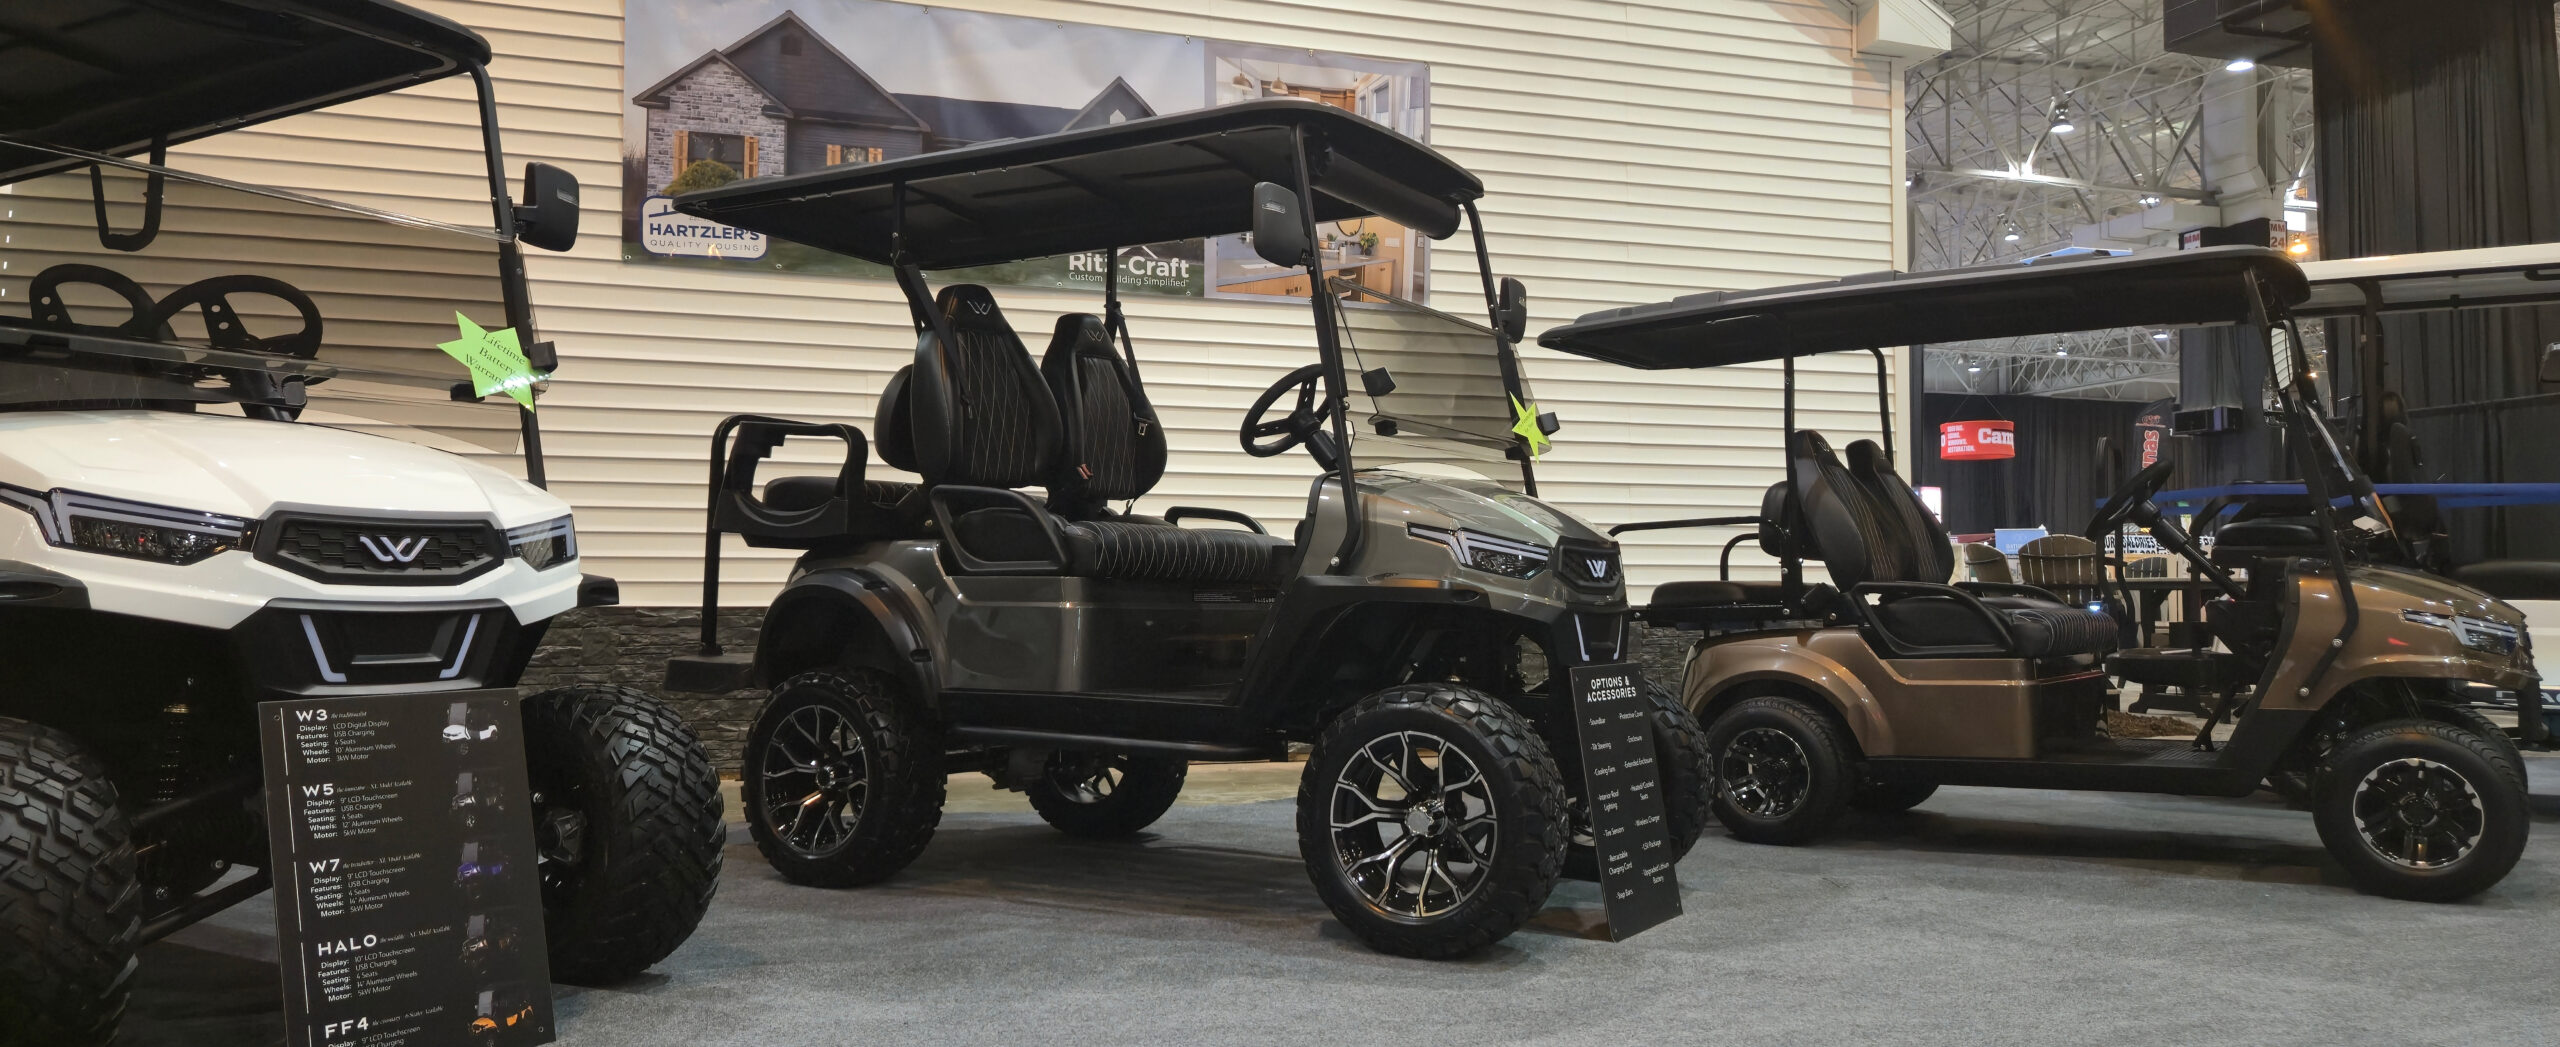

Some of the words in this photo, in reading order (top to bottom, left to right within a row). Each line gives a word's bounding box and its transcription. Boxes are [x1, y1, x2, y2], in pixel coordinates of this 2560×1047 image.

[650, 223, 760, 241] HARTZLER'S
[2270, 223, 2285, 232] MM
[650, 239, 702, 249] QUALITY
[2270, 237, 2285, 247] 24
[1069, 253, 1190, 278] Rit-Craft
[1069, 272, 1103, 282] Custom
[482, 332, 526, 365] Lifetime
[480, 347, 516, 375] Battery
[1591, 676, 1623, 689] OPTIONS
[1624, 675, 1630, 686] &
[1587, 686, 1637, 703] ACCESSORIES
[347, 721, 367, 730] Digital
[368, 720, 390, 728] Display
[347, 729, 375, 737] Charging
[345, 745, 374, 753] Aluminum
[306, 799, 335, 807] Display:
[347, 795, 361, 803] LCD
[362, 793, 398, 802] Touchscreen
[303, 807, 336, 815] Features:
[341, 804, 354, 812] USB
[354, 802, 382, 811] Charging
[307, 815, 336, 824] Seating:
[309, 823, 337, 831] Wheels:
[351, 819, 381, 827] Aluminum
[381, 816, 403, 824] Wheels
[1608, 865, 1624, 875] Charging
[1624, 861, 1633, 871] Cord
[313, 876, 342, 885] Display:
[354, 871, 368, 879] LCD
[369, 867, 405, 877] Touchscreen
[310, 884, 343, 894] Features:
[362, 877, 390, 886] Charging
[315, 892, 344, 902] Seating:
[353, 888, 371, 896] Seats
[316, 900, 344, 910] Wheels:
[358, 894, 388, 903] Aluminum
[388, 889, 410, 898] Wheels
[320, 909, 345, 918] Motor:
[350, 905, 364, 913] 5kW
[364, 903, 384, 911] Motor
[317, 934, 377, 957] HALO
[320, 959, 349, 969] Display:
[364, 953, 378, 961] LCD
[378, 946, 415, 958] Touchscreen
[317, 967, 350, 978] Features:
[355, 963, 368, 971] USB
[369, 958, 397, 969] Charging
[322, 976, 351, 986] Seating:
[361, 971, 378, 979] Seats
[323, 984, 352, 994] Wheels:
[365, 976, 396, 986] Aluminum
[396, 971, 418, 980] Wheels
[328, 993, 353, 1003] Motor:
[357, 988, 371, 997] 5kW
[372, 985, 391, 994] Motor
[324, 1016, 369, 1039] FF4
[369, 1033, 383, 1042] LCD
[383, 1026, 421, 1038] Touchscreen
